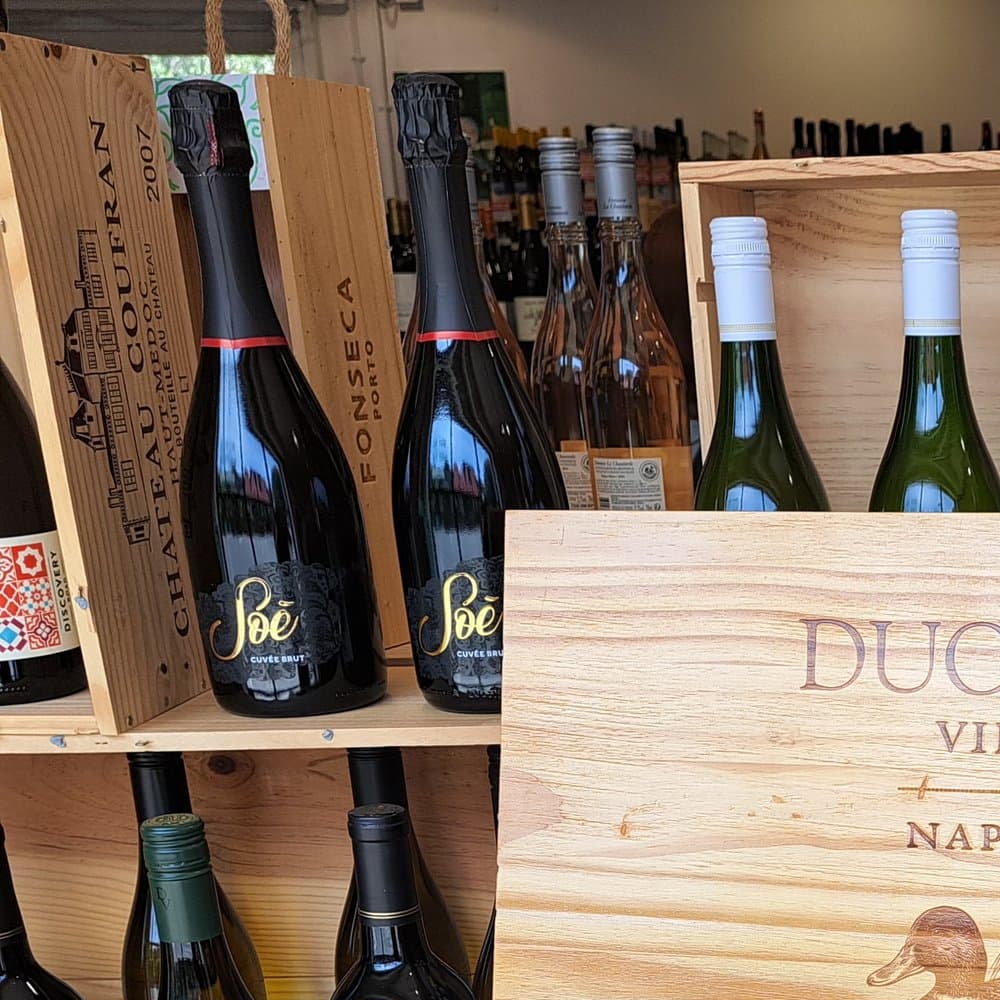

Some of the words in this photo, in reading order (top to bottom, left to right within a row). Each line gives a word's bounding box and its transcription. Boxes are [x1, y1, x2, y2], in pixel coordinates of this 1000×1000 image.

[136, 124, 160, 202] 2007
[89, 116, 144, 374] COUFRAN
[143, 243, 163, 320] CHATEAU
[159, 330, 168, 353] AU
[337, 276, 377, 484] FONSECA
[365, 340, 382, 420] PORTO
[138, 281, 180, 485] HAUT-MEDOC
[137, 402, 189, 637] CHATEAU
[49, 551, 71, 632] DISCOVERY
[250, 654, 280, 663] CUVÉE
[281, 654, 305, 664] BRUT
[456, 649, 486, 658] CUVÉE
